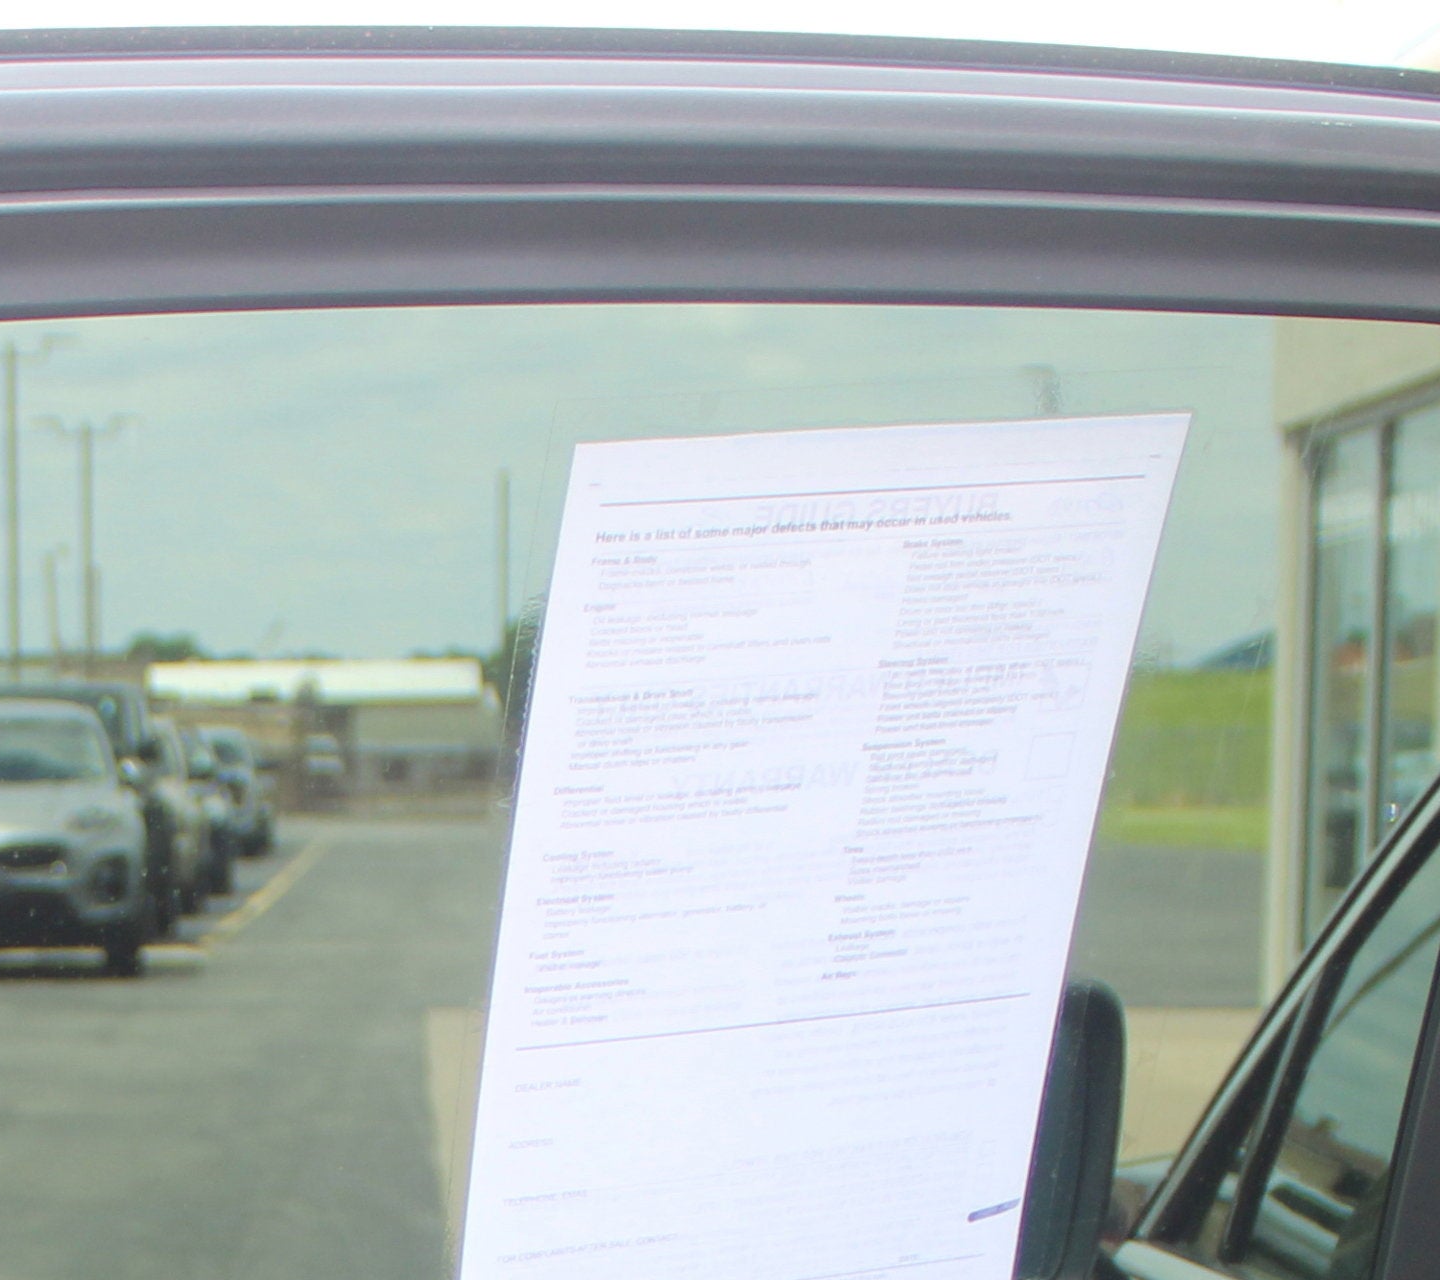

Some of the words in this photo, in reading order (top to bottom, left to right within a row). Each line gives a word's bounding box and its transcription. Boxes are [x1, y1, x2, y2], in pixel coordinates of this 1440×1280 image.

[595, 531, 625, 543] Here
[629, 530, 640, 541] is
[644, 531, 651, 540] a
[655, 528, 675, 539] list
[678, 527, 692, 538] of
[694, 527, 729, 537] some
[732, 525, 769, 538] major
[771, 521, 816, 533] defects
[820, 519, 845, 531] that
[846, 520, 873, 532] may
[877, 518, 911, 528] occur
[914, 515, 926, 526] in
[929, 514, 958, 525] used
[581, 850, 615, 861] System
[581, 893, 615, 904] System
[551, 949, 585, 960] System
[575, 978, 629, 989] Accessories
[514, 1081, 553, 1093] DEALER
[497, 1254, 516, 1264] FOR
[577, 1242, 607, 1252] AFTER
